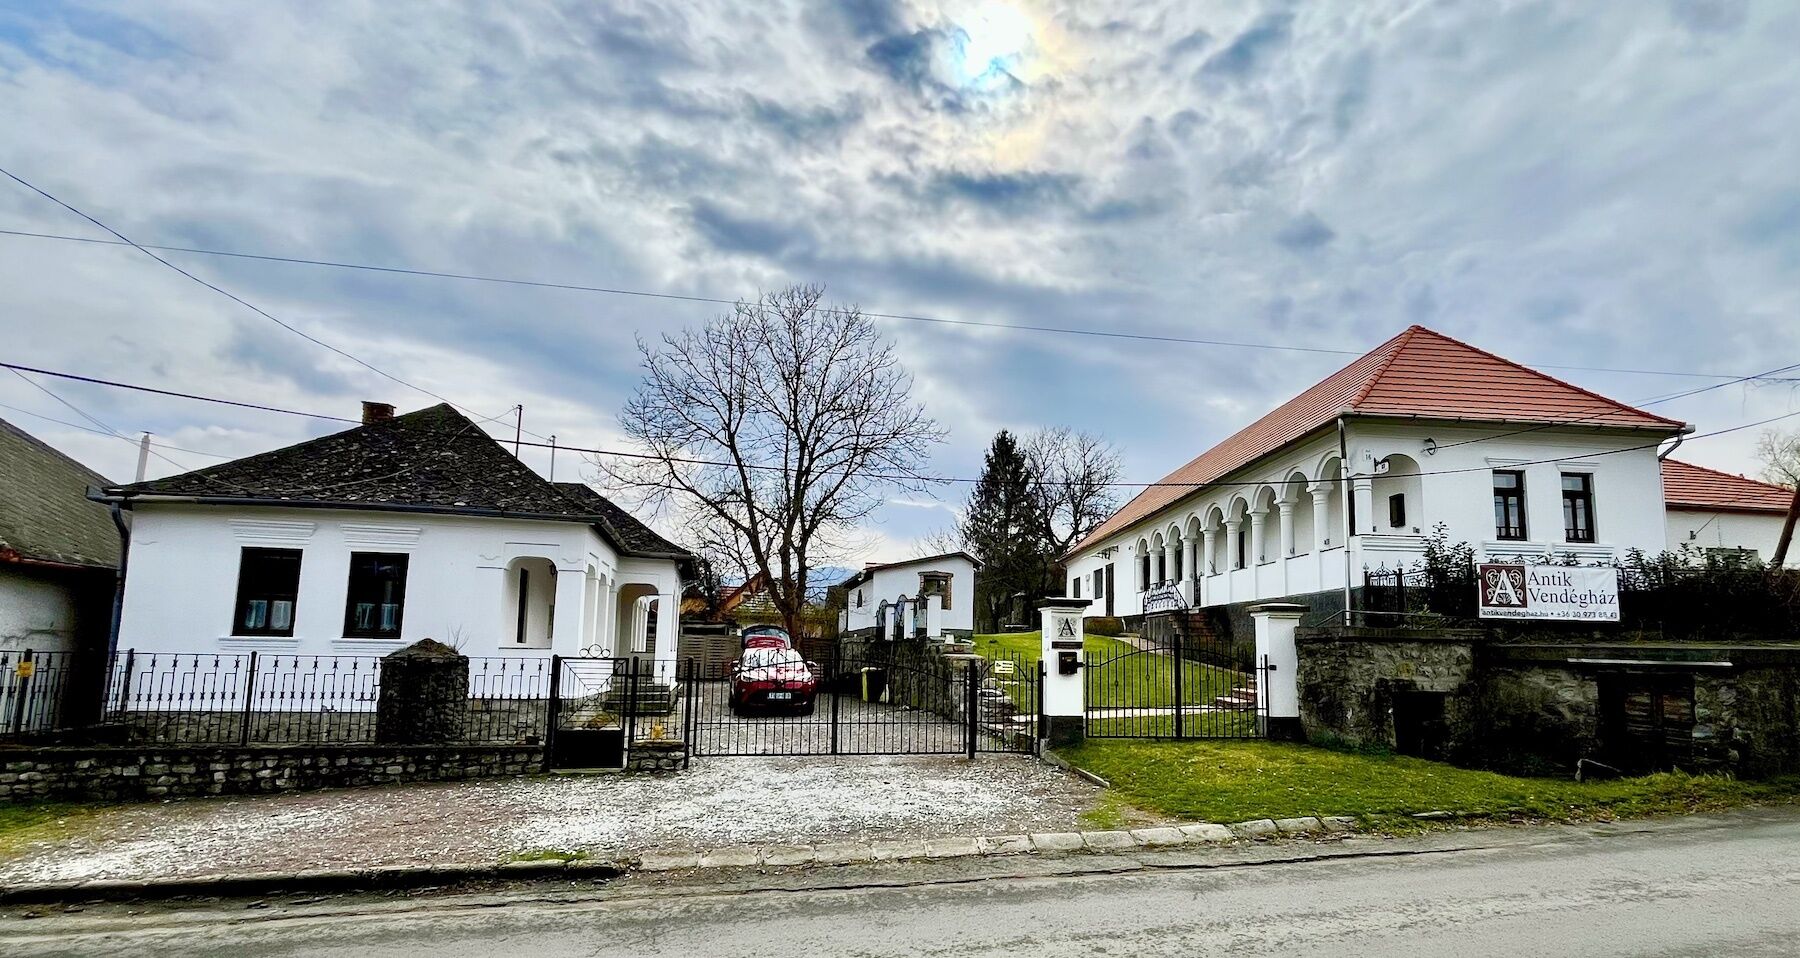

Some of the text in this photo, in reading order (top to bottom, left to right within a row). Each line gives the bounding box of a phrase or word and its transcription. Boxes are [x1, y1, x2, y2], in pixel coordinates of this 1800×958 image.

[1489, 569, 1522, 605] A
[1528, 571, 1572, 587] Antik
[1528, 588, 1617, 608] Vendégház
[1058, 617, 1076, 637] A
